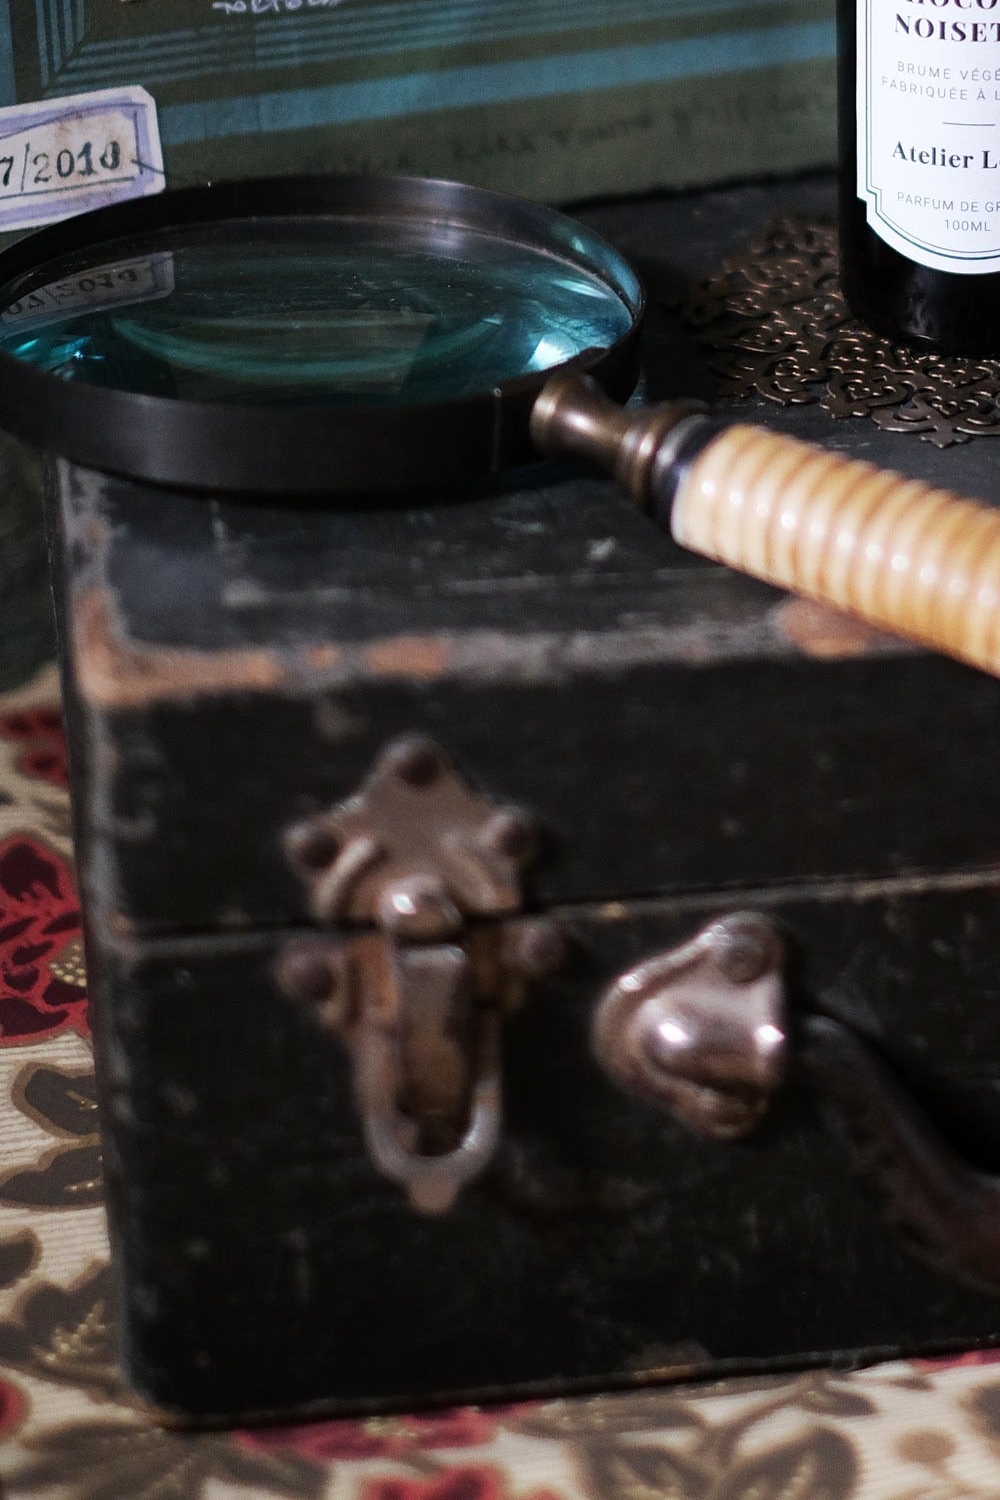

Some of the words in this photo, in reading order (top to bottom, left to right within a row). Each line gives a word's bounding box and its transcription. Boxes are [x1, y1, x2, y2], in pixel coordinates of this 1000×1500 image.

[897, 60, 952, 81] BRUME
[881, 76, 969, 101] FABRIQUÉE
[976, 85, 988, 101] À
[891, 139, 975, 170] Atelier
[896, 190, 956, 213] PARFUM
[959, 197, 979, 213] DE
[943, 218, 992, 232] 100ML
